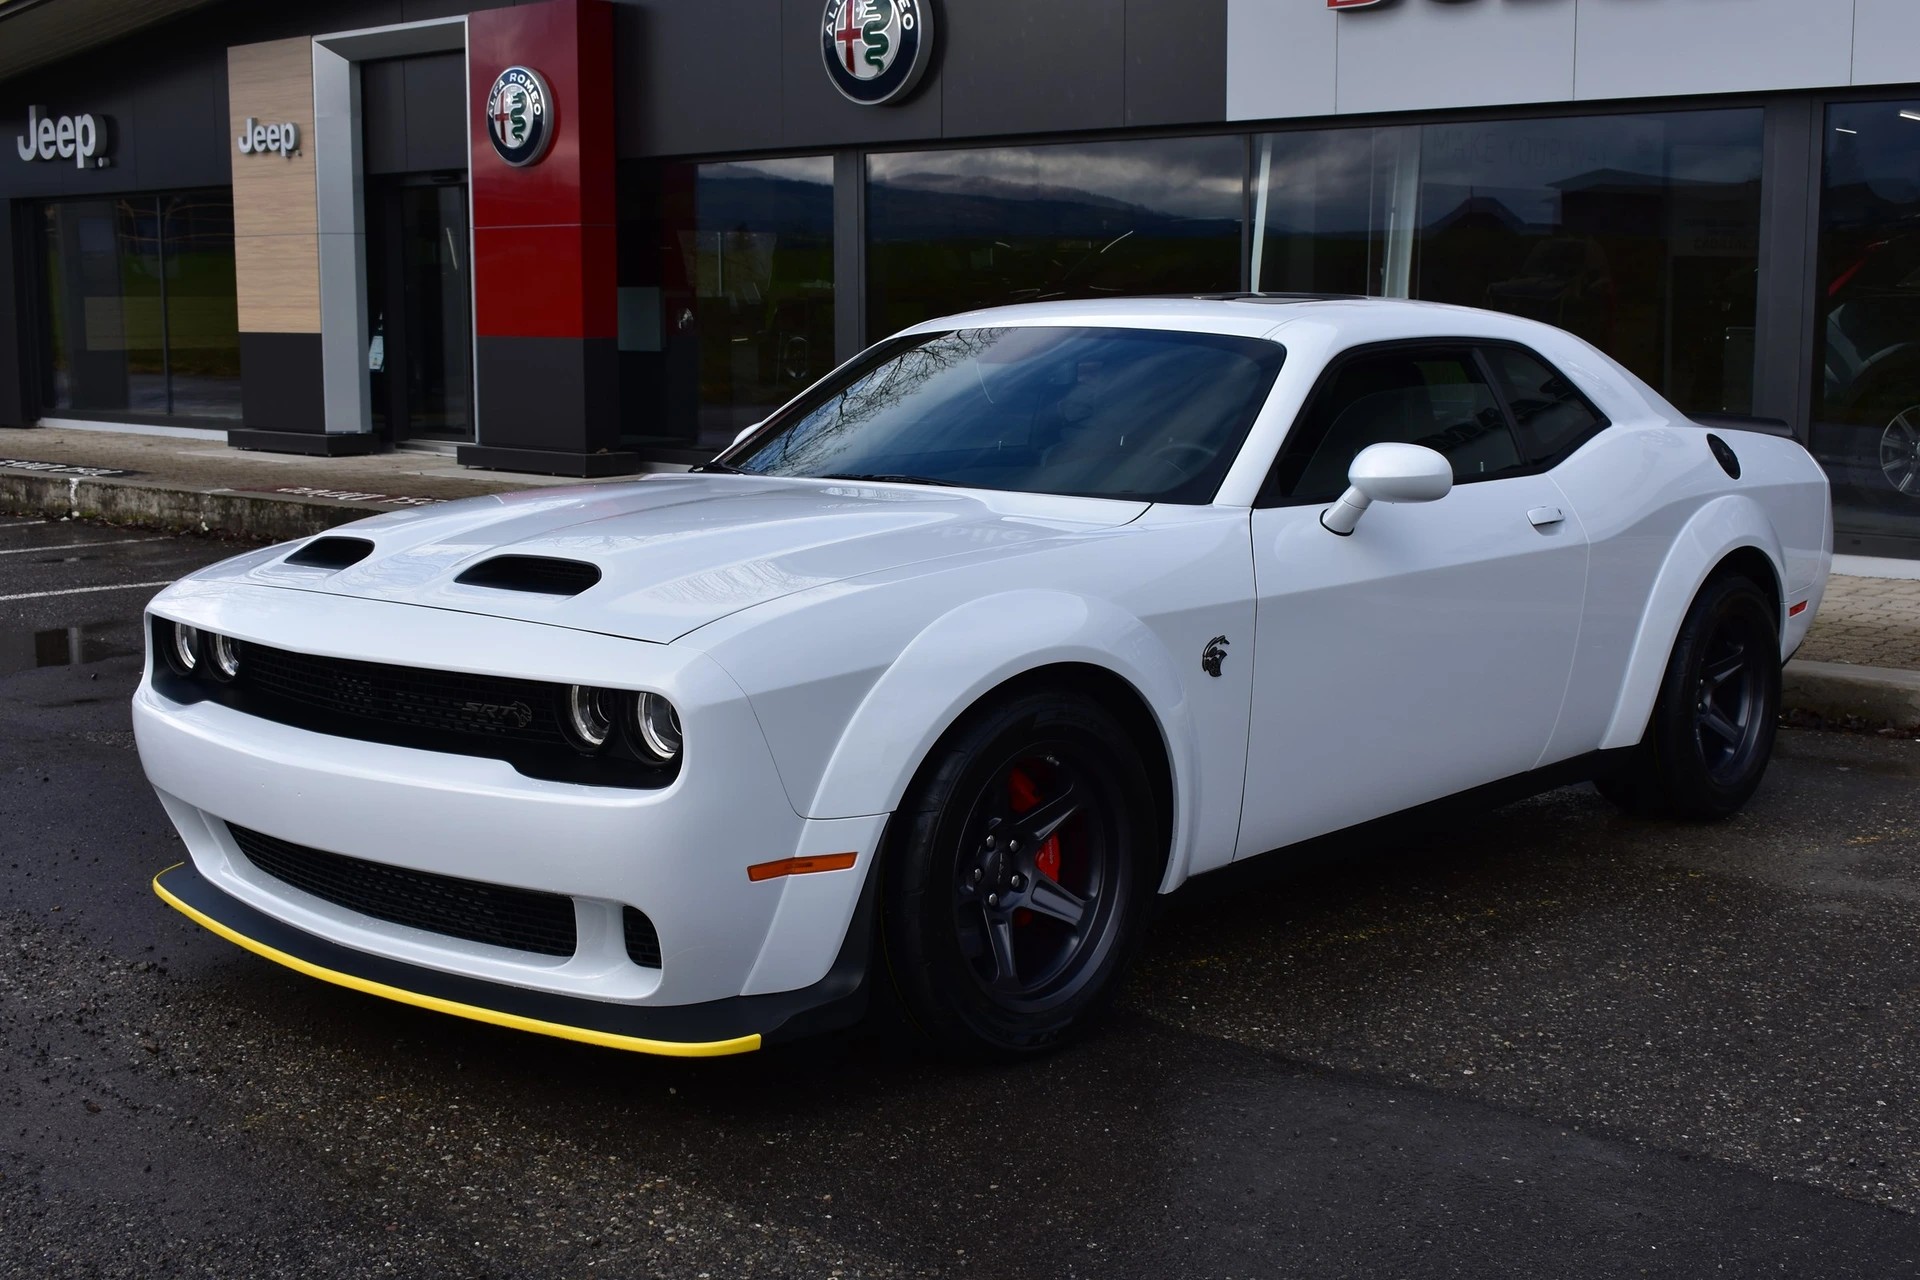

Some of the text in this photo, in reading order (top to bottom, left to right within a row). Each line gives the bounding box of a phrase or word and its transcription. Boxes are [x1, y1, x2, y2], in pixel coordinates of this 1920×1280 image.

[826, 0, 841, 37] AL
[489, 73, 541, 118] ALFA ROMEO
[17, 105, 97, 169] Jeep
[237, 117, 295, 157] Jeep
[461, 702, 518, 719] SRT
